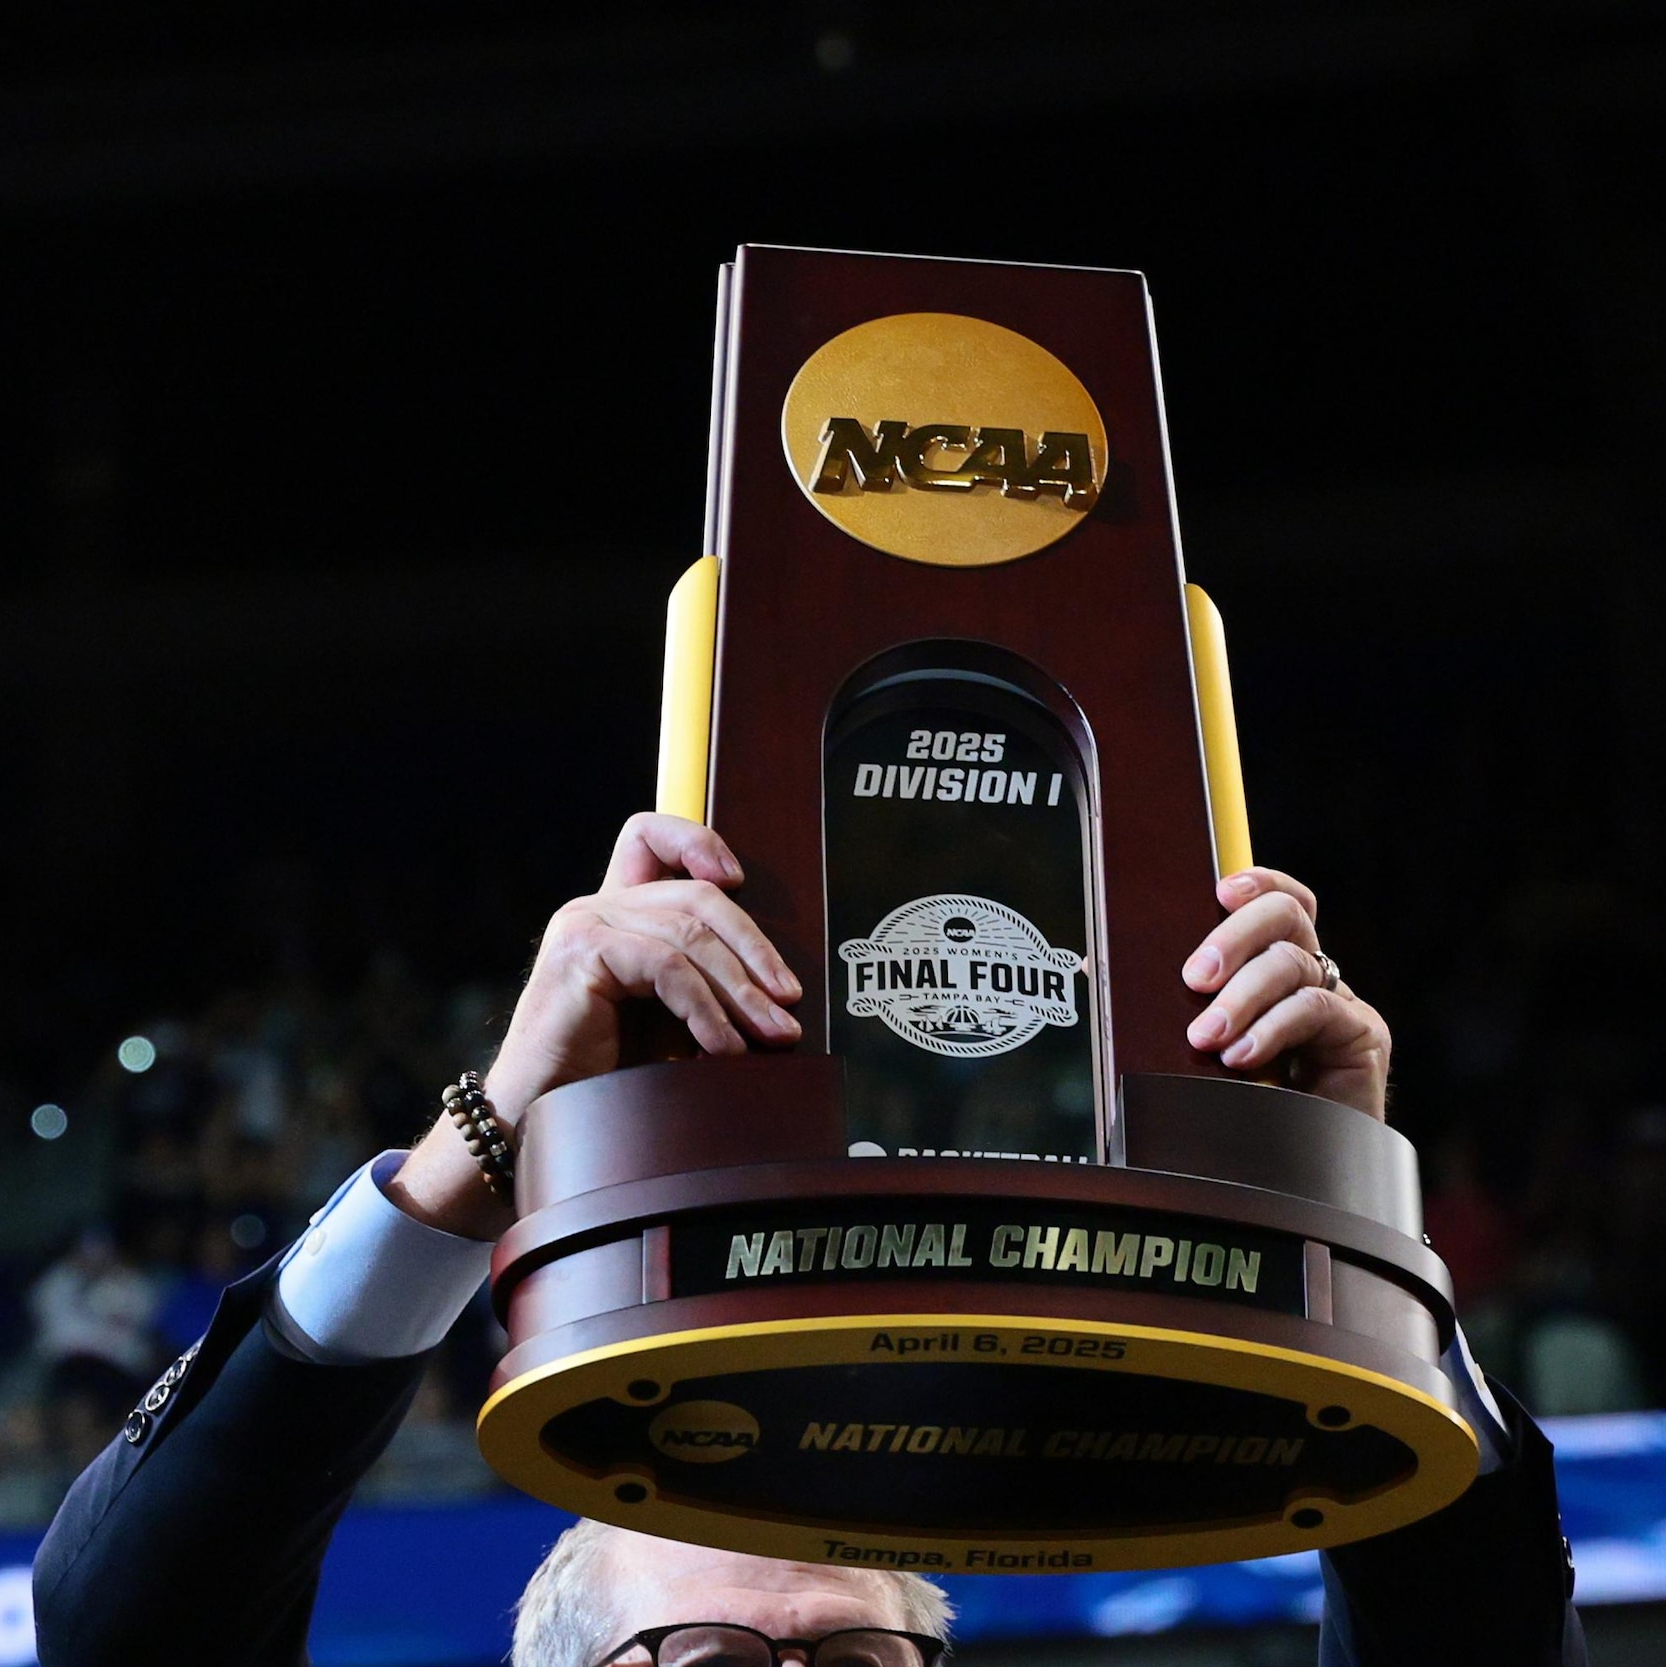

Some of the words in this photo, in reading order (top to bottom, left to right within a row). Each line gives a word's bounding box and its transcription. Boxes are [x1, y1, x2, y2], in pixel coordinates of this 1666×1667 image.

[811, 416, 1099, 511] NCAA
[906, 730, 1007, 763] 2025
[853, 763, 1037, 806] DIVISION
[1047, 773, 1063, 806] I
[946, 928, 975, 937] NCAA
[903, 947, 940, 956] 2025
[947, 948, 1018, 960] WOMEN'S
[856, 959, 957, 992] FINAL
[970, 960, 1067, 1003] FOUR
[922, 993, 969, 1002] TAMPA
[976, 994, 1001, 1003] BAY
[725, 1223, 973, 1280] NATIONAL
[989, 1224, 1261, 1293] CHAMPION
[870, 1332, 960, 1356] April
[973, 1333, 1007, 1356] 6,
[1020, 1336, 1127, 1360] 2025
[661, 1428, 757, 1449] NCAA
[798, 1421, 1027, 1458] NATIONAL
[1042, 1429, 1305, 1467] CHAMPION
[822, 1540, 951, 1569] Tampa,
[965, 1547, 1093, 1569] Florida
